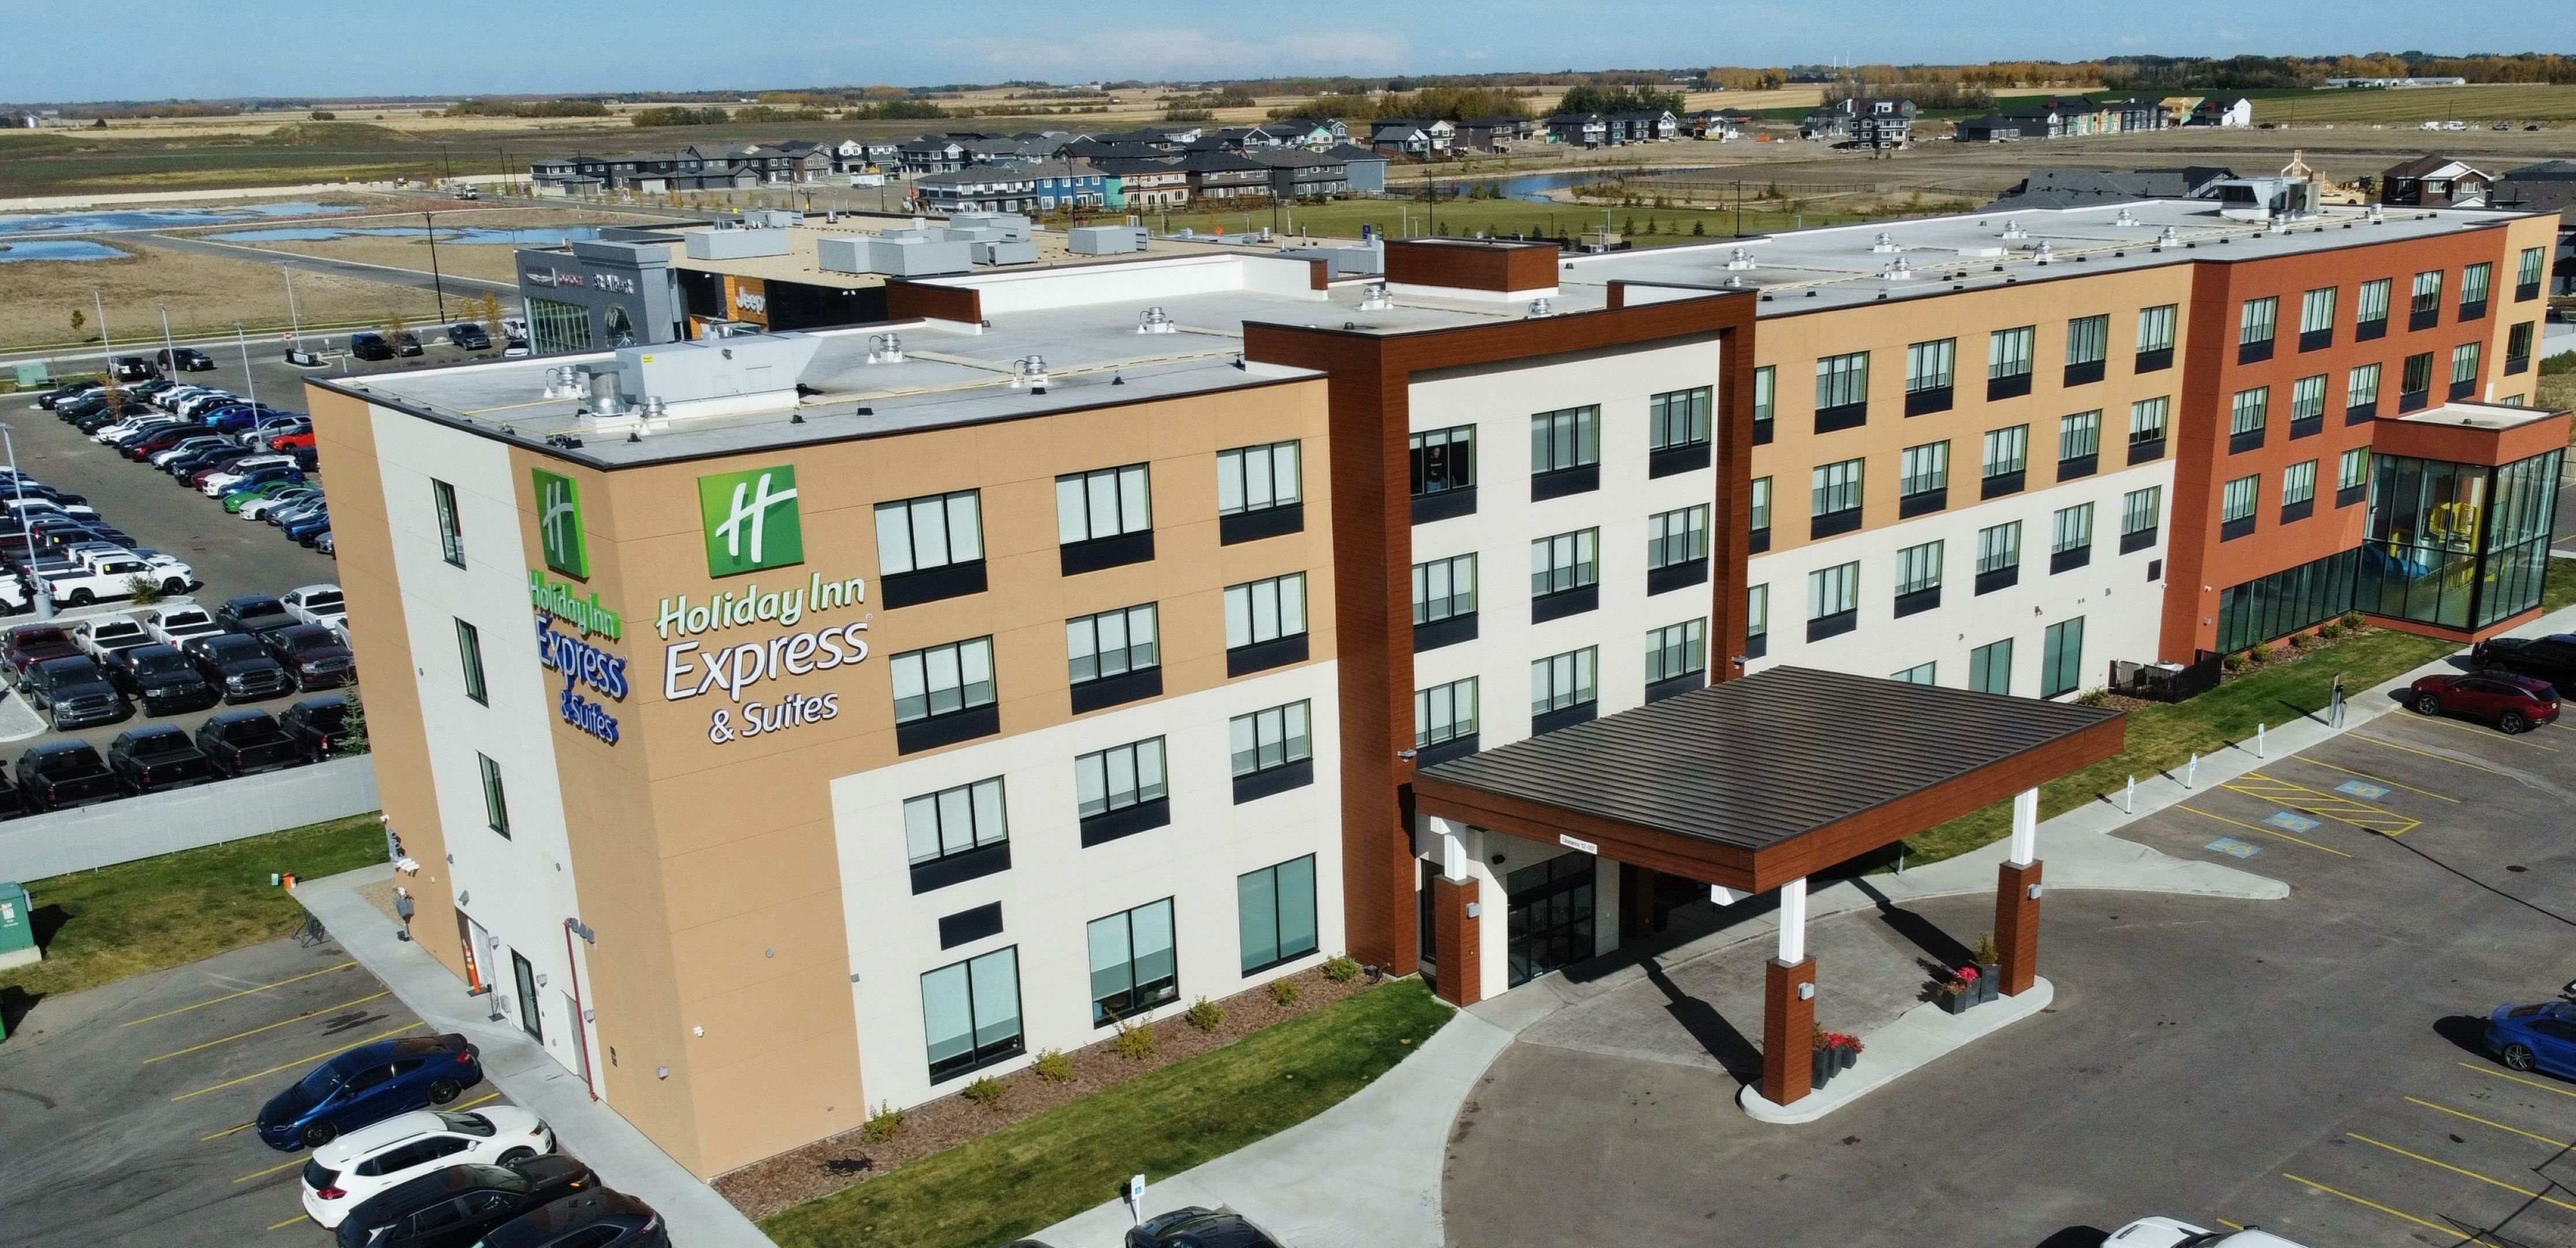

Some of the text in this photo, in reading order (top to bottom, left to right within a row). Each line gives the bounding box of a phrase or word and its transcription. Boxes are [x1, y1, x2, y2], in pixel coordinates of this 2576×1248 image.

[736, 287, 763, 315] Jeep
[529, 569, 621, 639] Holiday Inn
[655, 571, 865, 638] Holiday Inn
[535, 613, 628, 698] Express
[663, 622, 869, 701] Express
[559, 689, 619, 743] & Suites
[709, 693, 839, 744] & Suites
